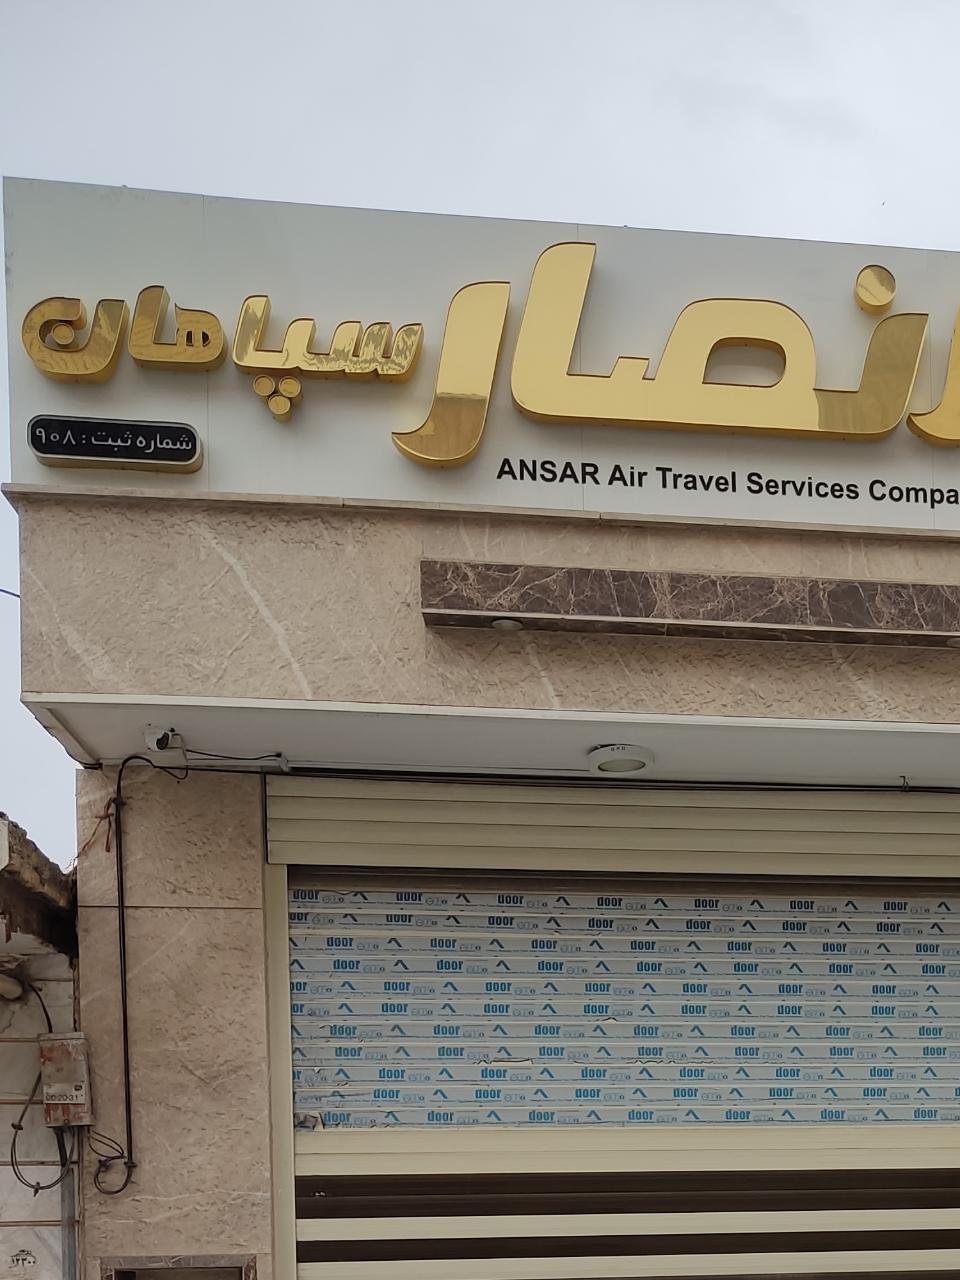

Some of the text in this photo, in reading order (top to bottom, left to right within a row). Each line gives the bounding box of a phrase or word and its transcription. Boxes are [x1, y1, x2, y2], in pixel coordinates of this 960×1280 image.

[21, 284, 424, 421] سپاهان
[136, 432, 192, 453] شماره
[496, 457, 601, 486] ANSAR
[607, 464, 649, 488] Air
[655, 466, 737, 493] Travel
[746, 471, 860, 500] Services
